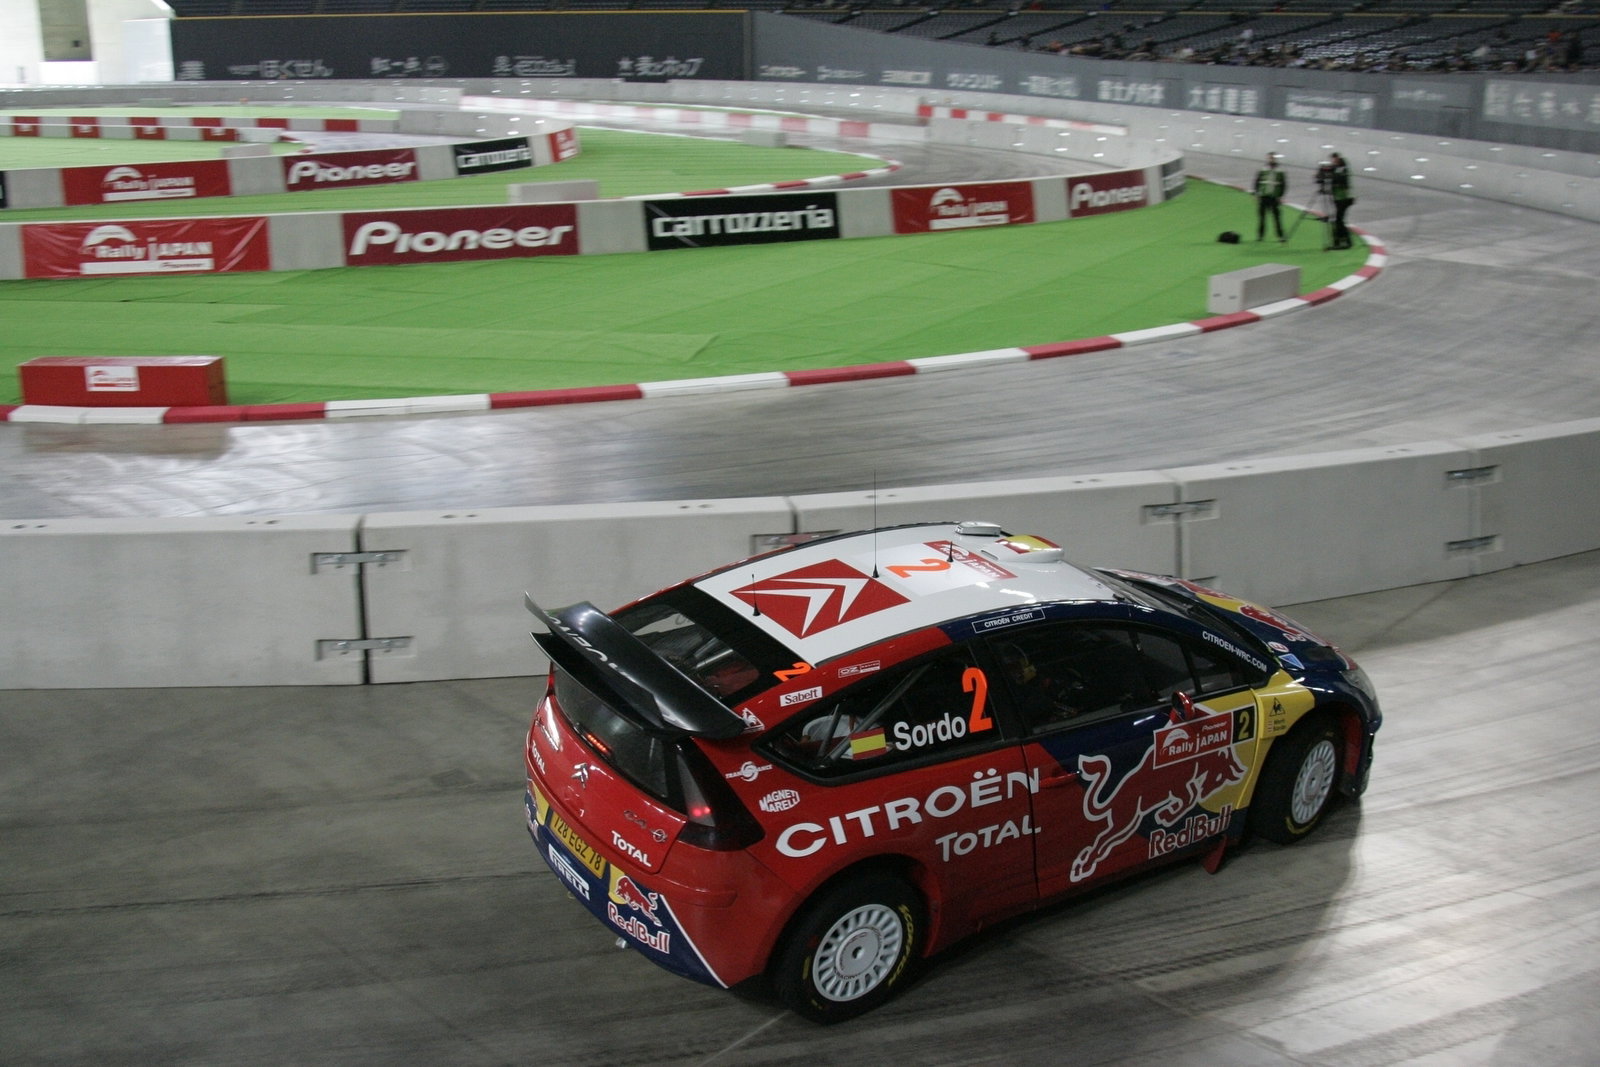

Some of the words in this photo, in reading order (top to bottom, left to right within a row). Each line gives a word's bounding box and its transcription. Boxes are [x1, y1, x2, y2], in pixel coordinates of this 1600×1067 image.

[288, 160, 416, 184] Pioneer
[1071, 182, 1147, 210] Pioneer
[350, 221, 575, 255] Pioneer
[885, 557, 952, 578] 2
[983, 618, 1010, 629] CITROËN
[1011, 612, 1034, 623] CREDIT
[1202, 630, 1268, 673] CITROEN-WRC.COM
[773, 662, 811, 683] 2
[784, 687, 819, 705] Sabelt
[962, 667, 993, 733] 2
[894, 712, 966, 750] Sordo
[1238, 711, 1250, 740] 2
[532, 740, 546, 775] TOTAL
[1168, 742, 1193, 756] Rally
[775, 767, 1039, 858] CITROËN
[611, 830, 652, 868] TOTAL
[935, 815, 1041, 863] TOTAL
[549, 843, 590, 901] PIRELLI
